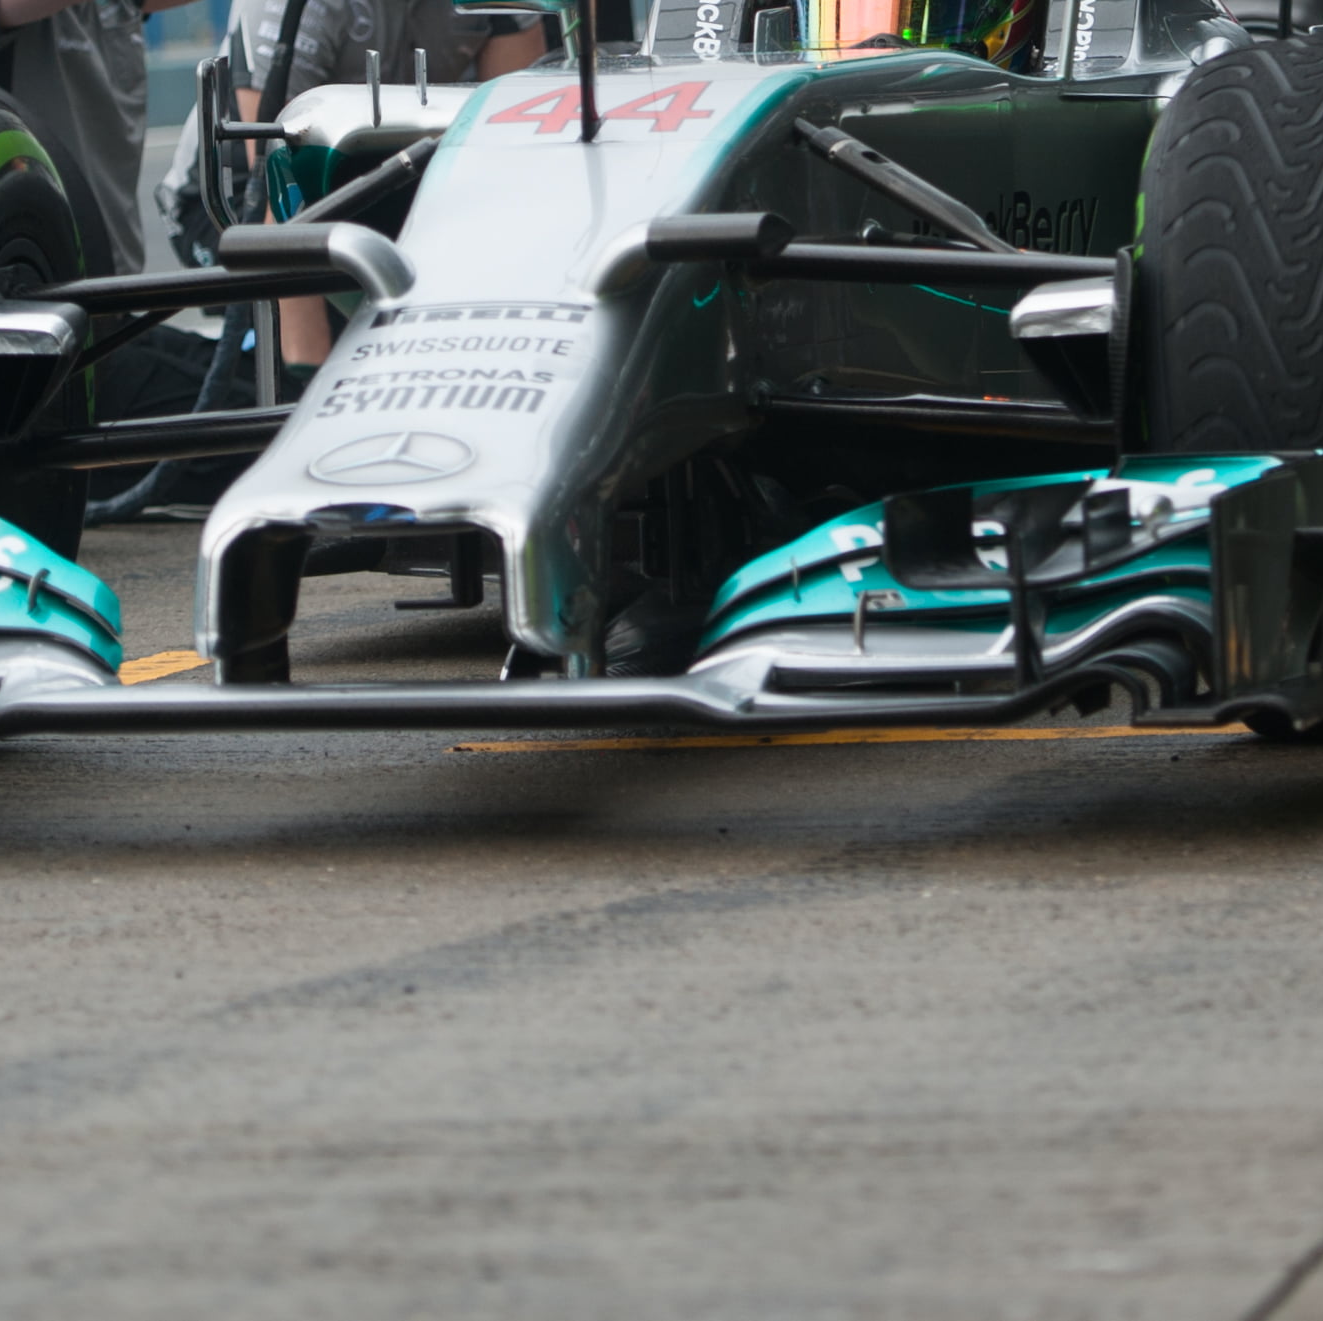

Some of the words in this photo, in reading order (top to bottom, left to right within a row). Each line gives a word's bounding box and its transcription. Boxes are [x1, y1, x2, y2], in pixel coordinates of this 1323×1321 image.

[486, 81, 714, 134] 44
[369, 300, 593, 329] PIRELLI
[351, 336, 575, 362] SWISSQUOTE
[332, 369, 555, 391] PETRONAS
[316, 385, 546, 418] SYNTIUM
